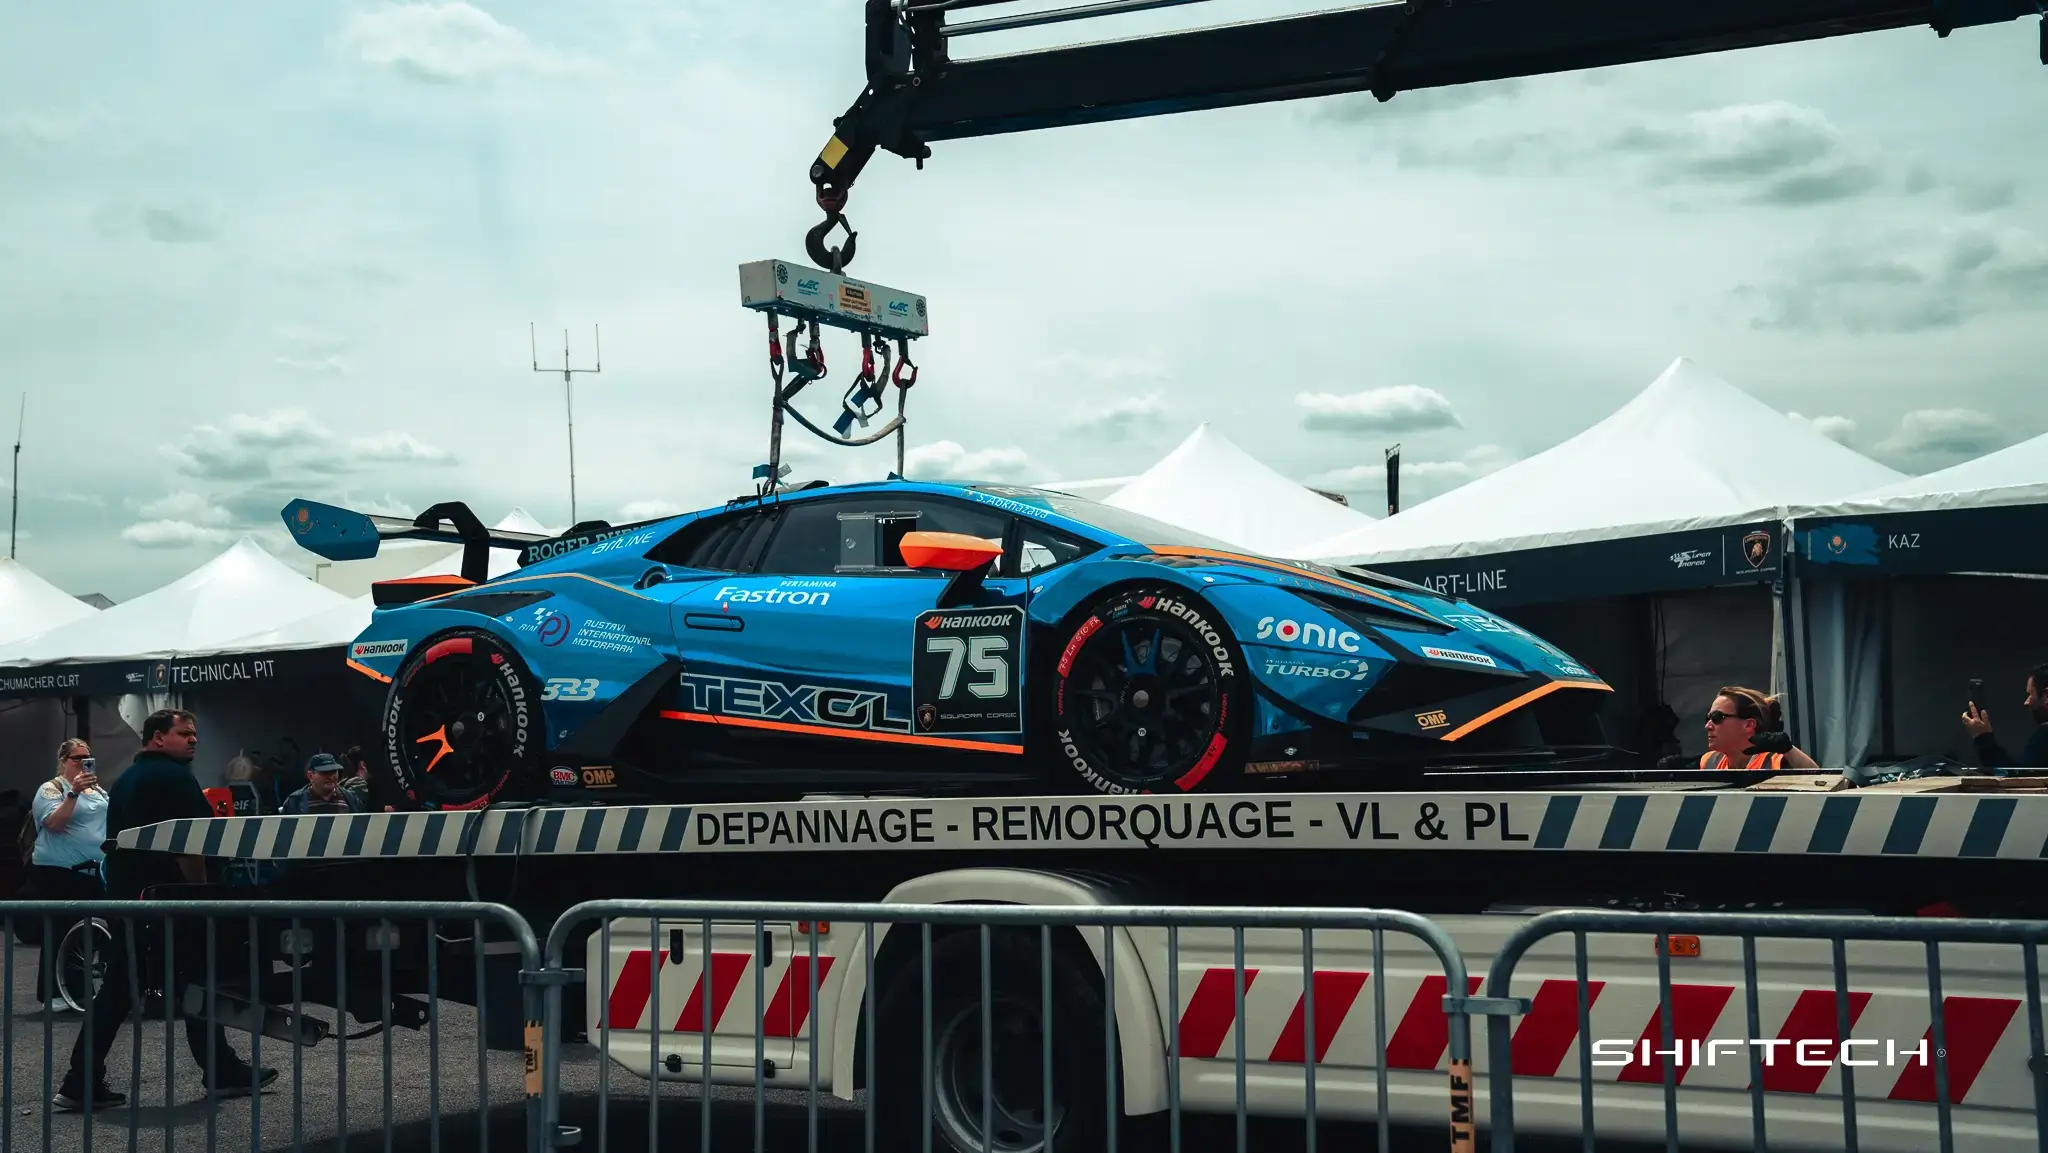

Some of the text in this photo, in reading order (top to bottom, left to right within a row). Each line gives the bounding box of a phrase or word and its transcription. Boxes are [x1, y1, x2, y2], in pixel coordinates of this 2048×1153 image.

[797, 279, 820, 290] WEC
[888, 301, 909, 312] WEC
[1888, 533, 1921, 549] KAZ
[779, 580, 837, 588] PERTAMINA
[1424, 569, 1508, 594] ART-LINE
[714, 586, 831, 605] Fastron
[518, 623, 538, 631] RIM
[584, 619, 626, 631] RUSTAVI
[577, 629, 652, 646] INTERNATIONAL
[572, 638, 634, 653] MOTORPARK
[171, 660, 275, 684] TECHNICAL PIT
[927, 636, 1009, 699] 75
[1265, 664, 1351, 679] TURBO
[57, 674, 80, 687] CLRT
[1417, 712, 1447, 727] OMP
[553, 771, 576, 781] BMC
[582, 769, 615, 785] OMP
[696, 808, 935, 845] DEPANNAGE
[972, 801, 1295, 849] REMORQUAGE
[1336, 801, 1400, 840] VL
[1414, 802, 1449, 841] &
[1465, 802, 1530, 842] PL
[1450, 1075, 1470, 1145] TMF
